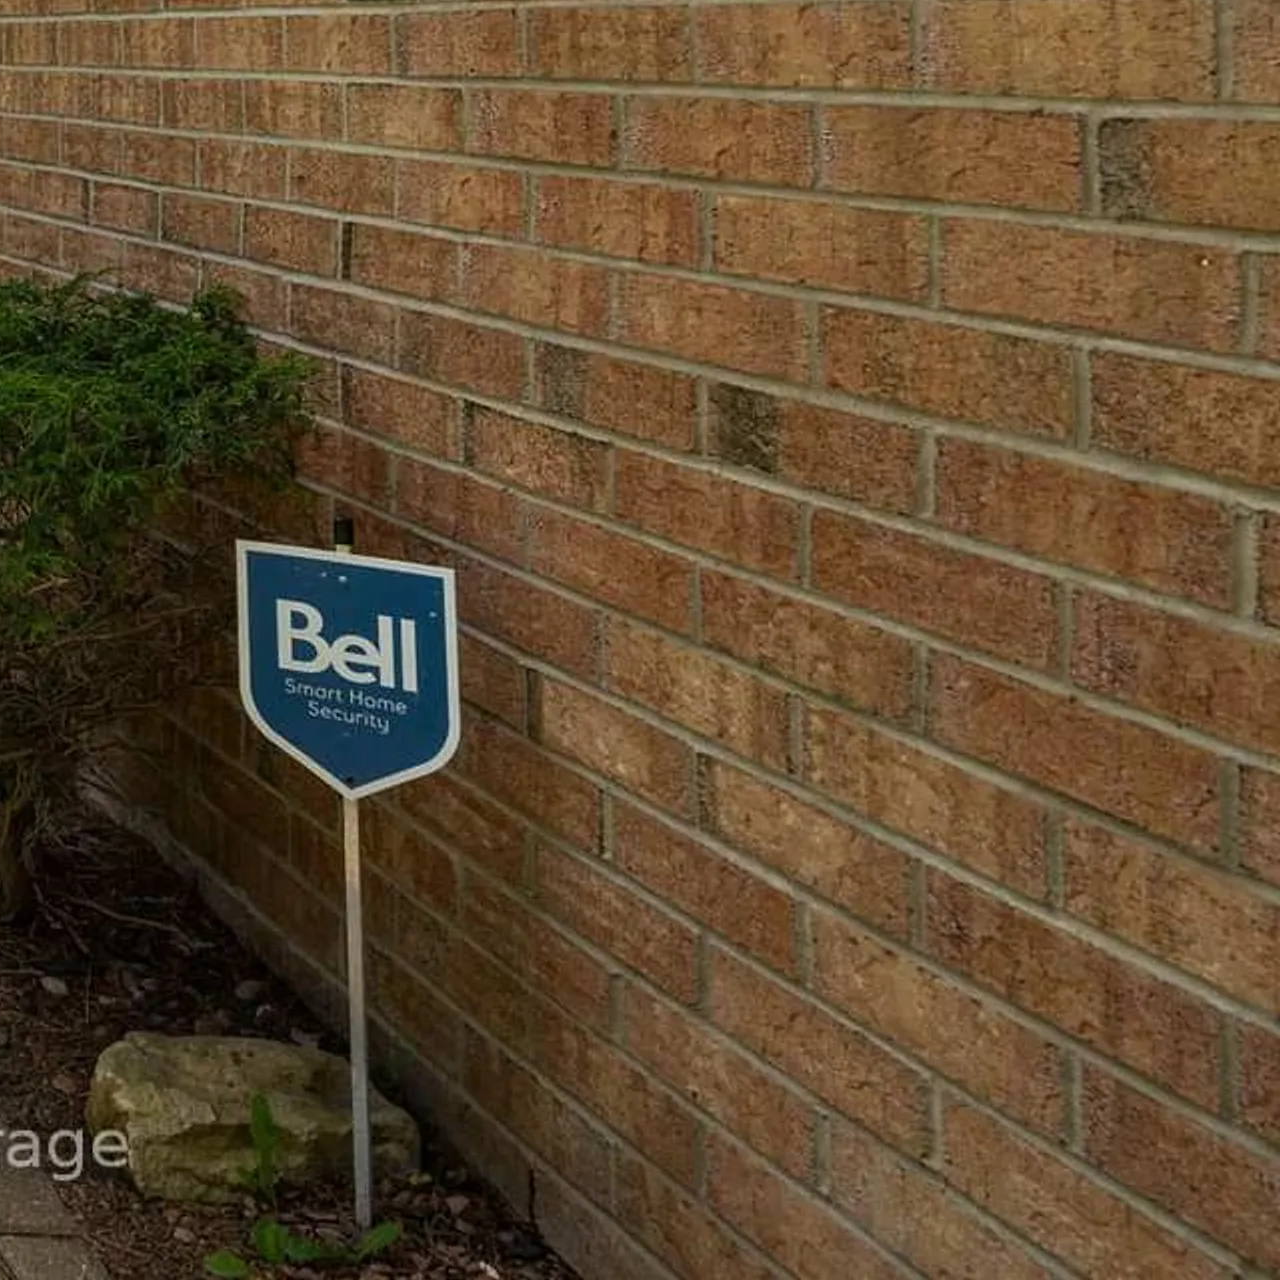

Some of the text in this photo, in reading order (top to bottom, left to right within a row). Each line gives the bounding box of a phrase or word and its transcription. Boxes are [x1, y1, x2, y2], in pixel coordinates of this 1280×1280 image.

[276, 598, 418, 693] Bell
[284, 678, 408, 716] Smart Home
[307, 701, 390, 735] Security
